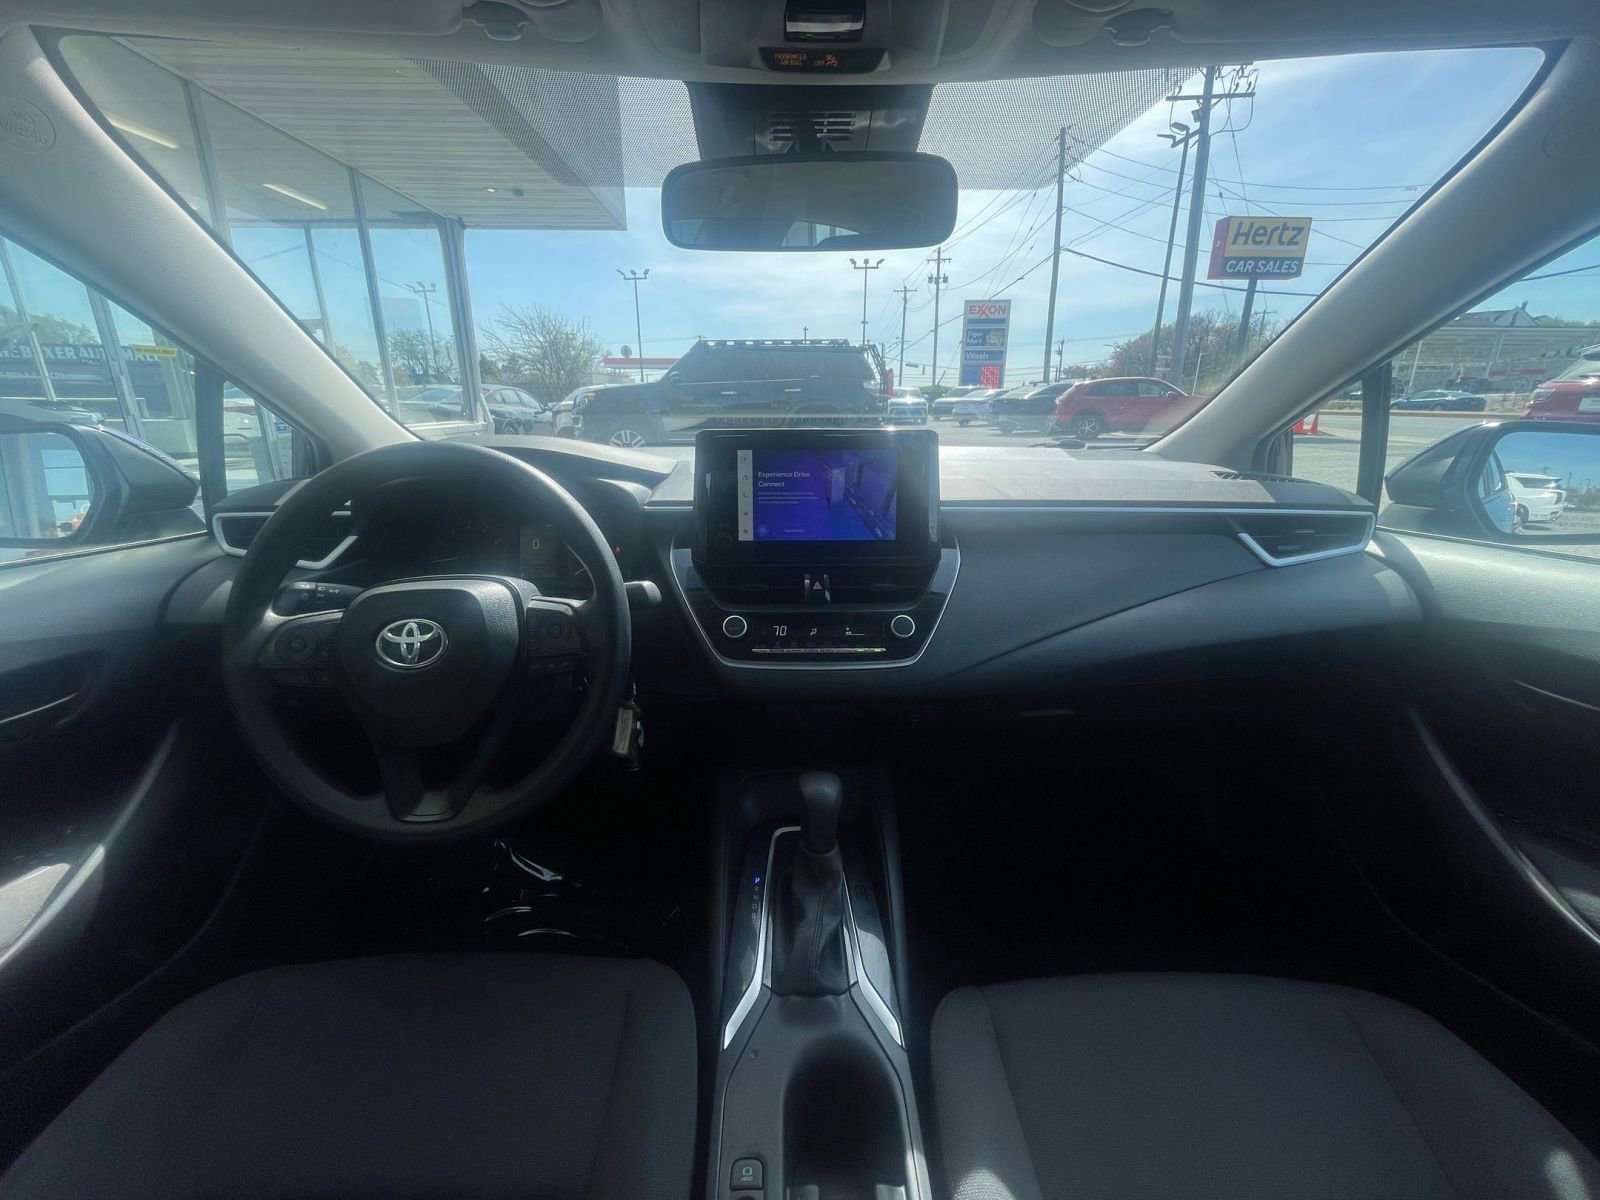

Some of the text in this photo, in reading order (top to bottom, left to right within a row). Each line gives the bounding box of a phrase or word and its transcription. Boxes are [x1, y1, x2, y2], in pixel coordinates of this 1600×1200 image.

[1231, 221, 1305, 246] Hertz
[1225, 260, 1299, 273] CAR SALES
[968, 303, 1007, 317] EXXON
[22, 346, 79, 360] BXER
[965, 351, 989, 360] Wash
[758, 471, 793, 479] Experience
[773, 625, 787, 636] 70
